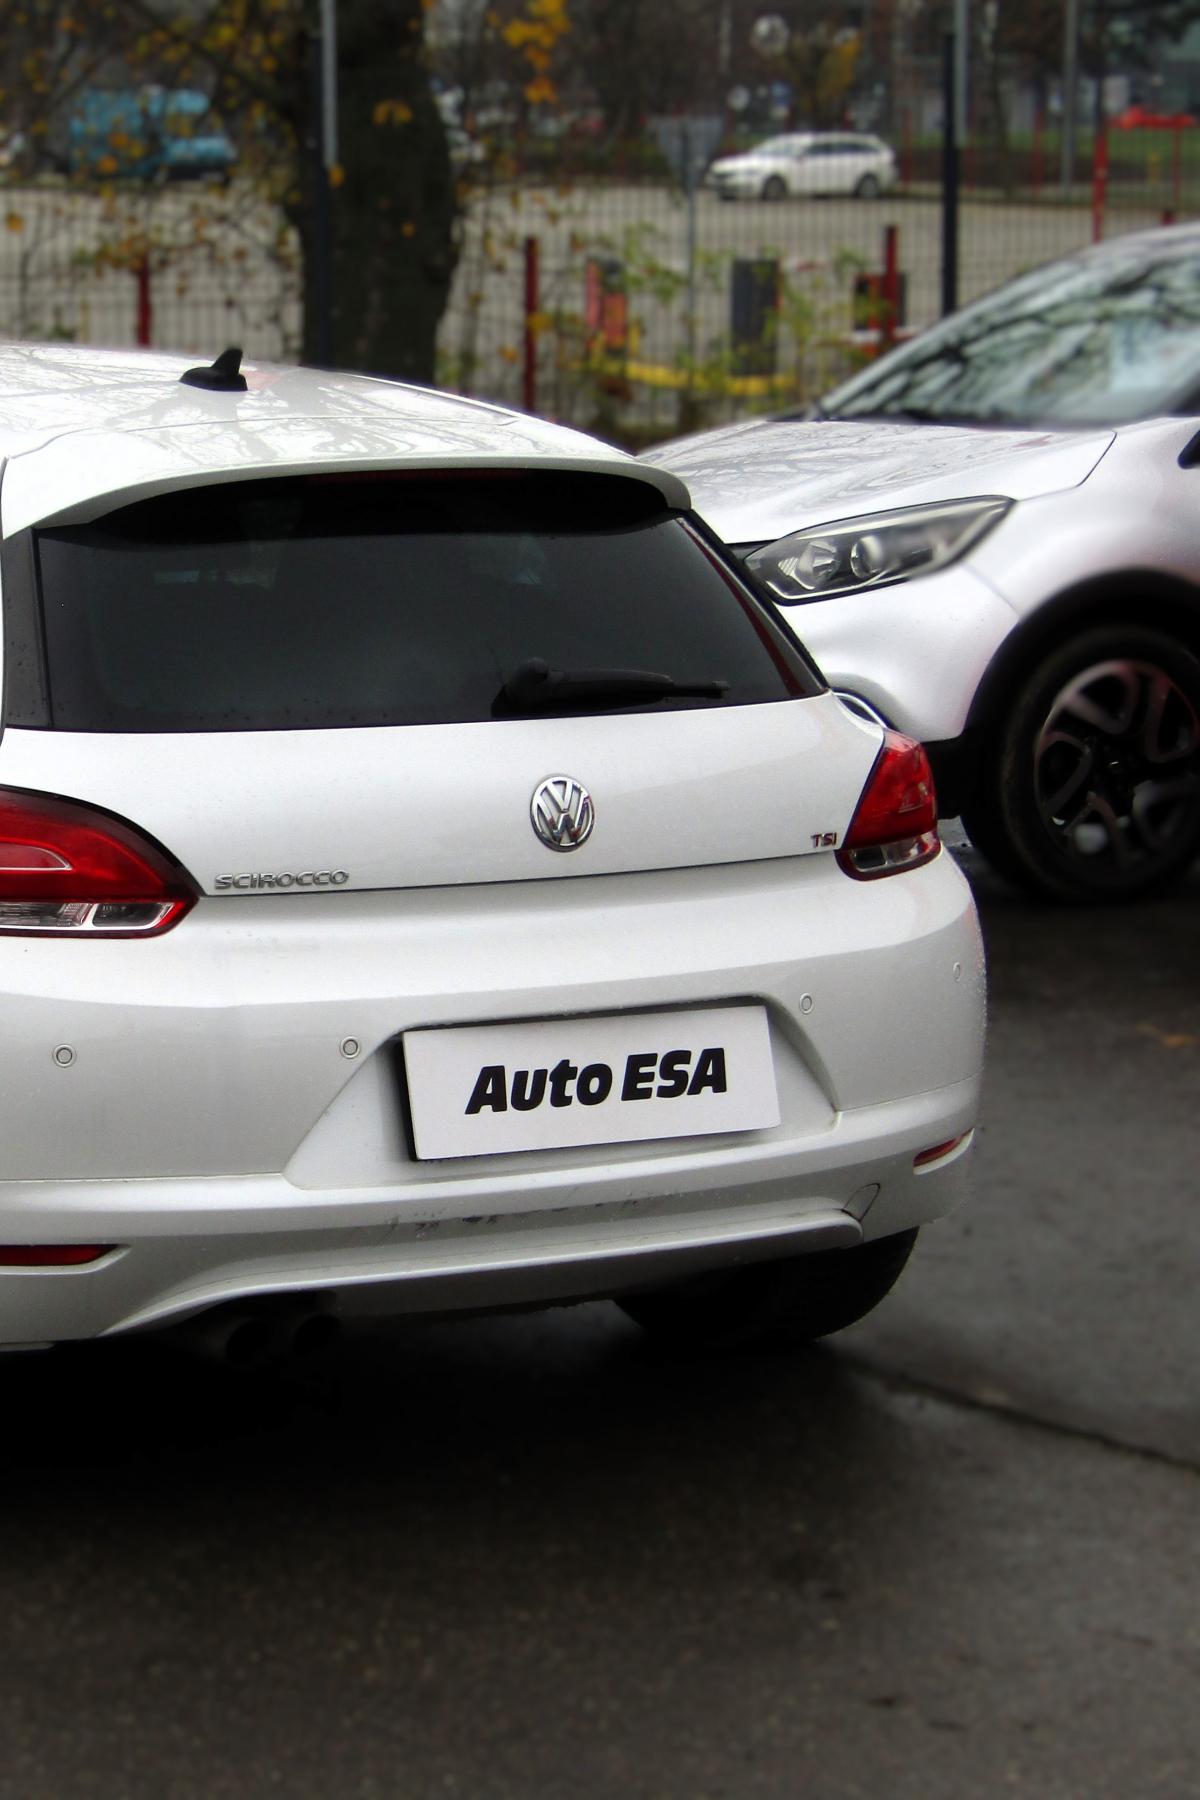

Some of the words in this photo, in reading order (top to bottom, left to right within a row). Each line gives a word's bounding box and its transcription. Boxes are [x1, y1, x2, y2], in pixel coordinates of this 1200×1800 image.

[811, 832, 837, 847] TSI
[215, 869, 349, 889] SCIROCCO
[465, 1059, 612, 1115] Auto
[621, 1048, 727, 1101] ESA
